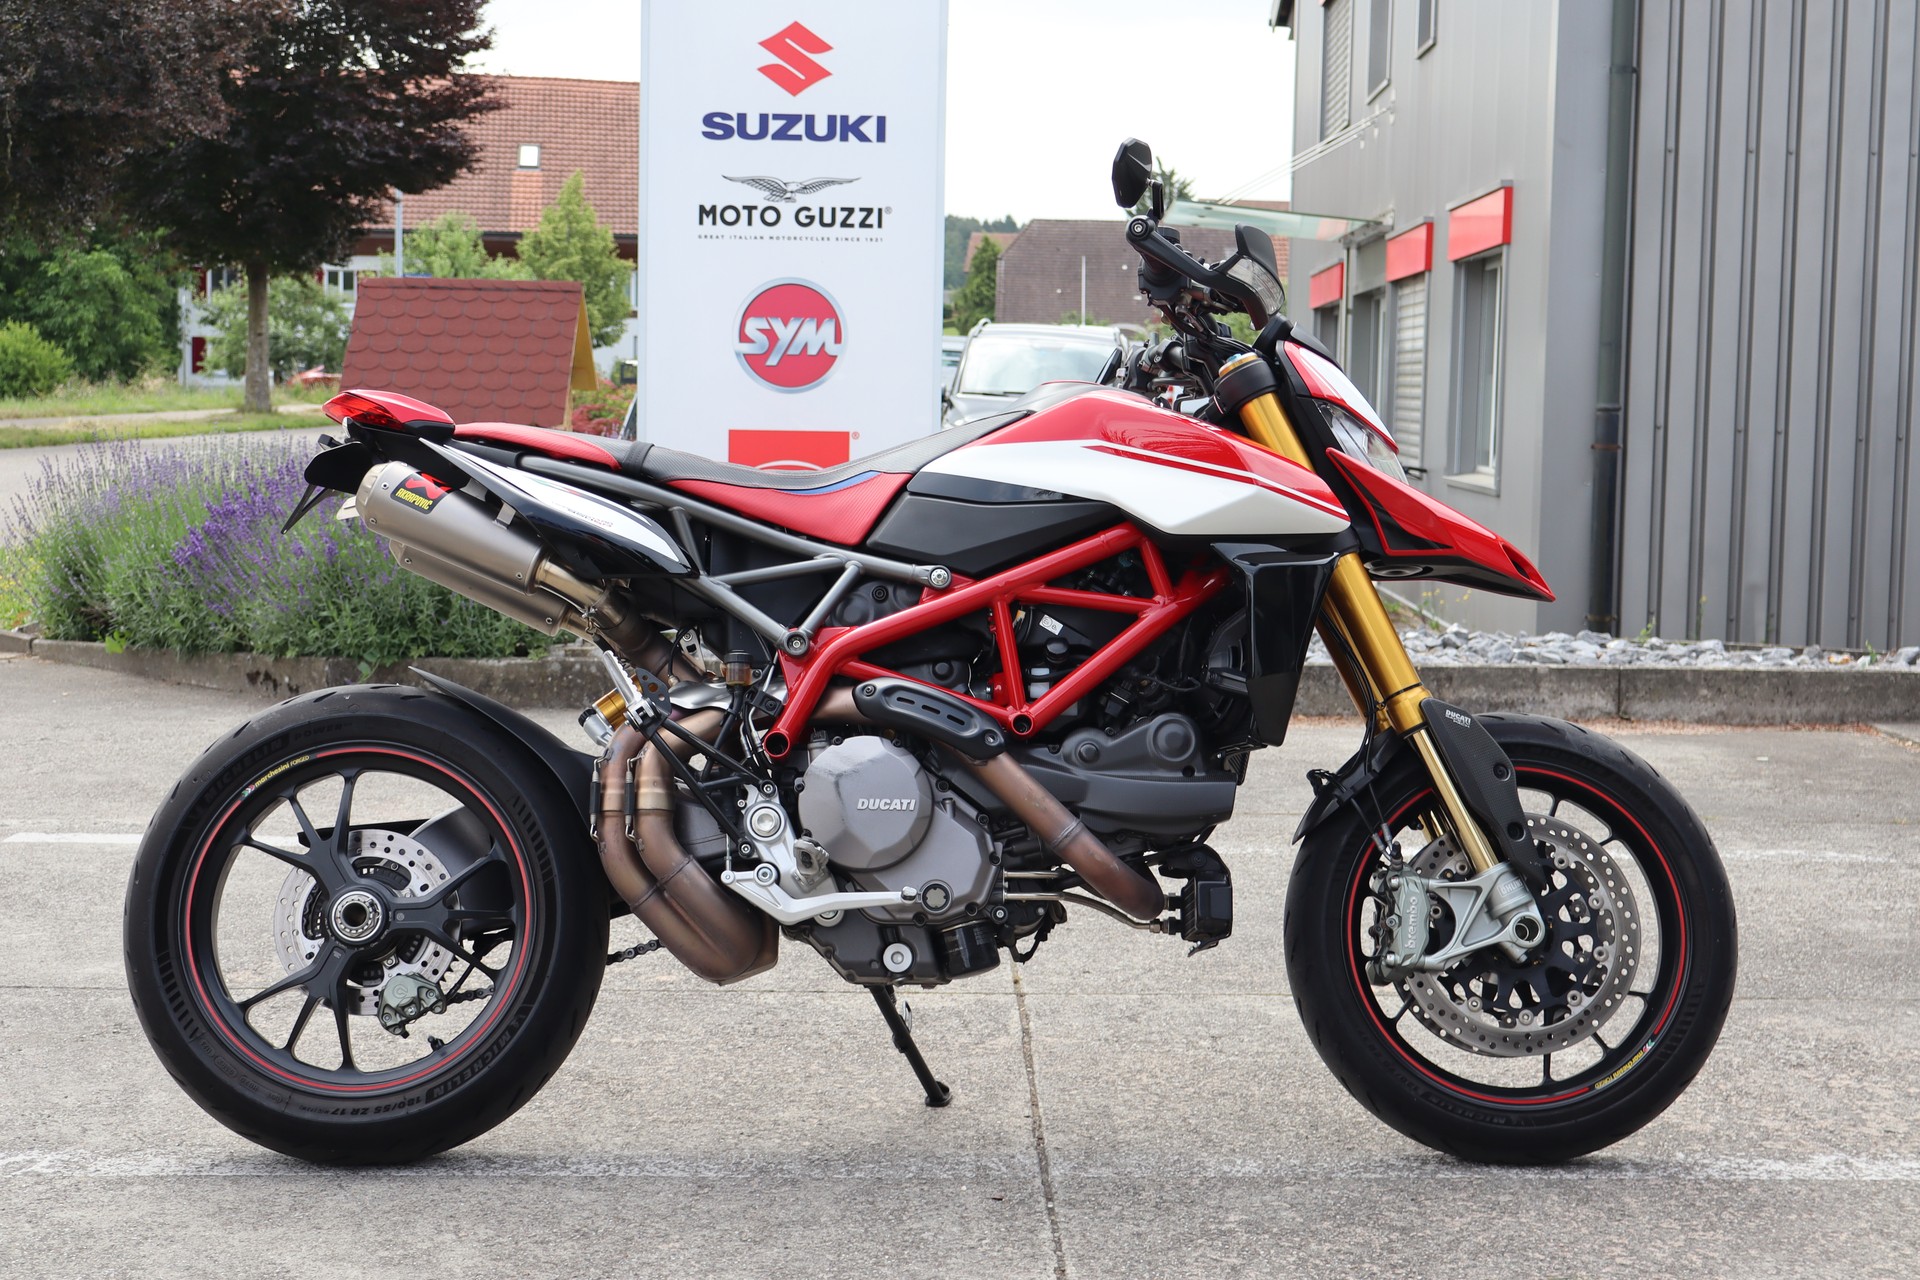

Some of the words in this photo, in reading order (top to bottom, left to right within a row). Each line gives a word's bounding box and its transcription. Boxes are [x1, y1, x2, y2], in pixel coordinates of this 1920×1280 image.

[701, 112, 886, 143] SUZUKI
[699, 204, 781, 227] MOTO
[794, 206, 883, 229] GUZZI
[738, 316, 842, 367] SYM
[1445, 709, 1471, 725] DUCATI
[203, 737, 284, 803] MICHELIN
[254, 762, 290, 788] marchesini
[857, 798, 916, 811] DUCATI
[1404, 896, 1418, 949] brembo
[432, 1030, 512, 1099] MICHELIN
[331, 1106, 347, 1116] 17
[350, 1107, 369, 1116] ZR
